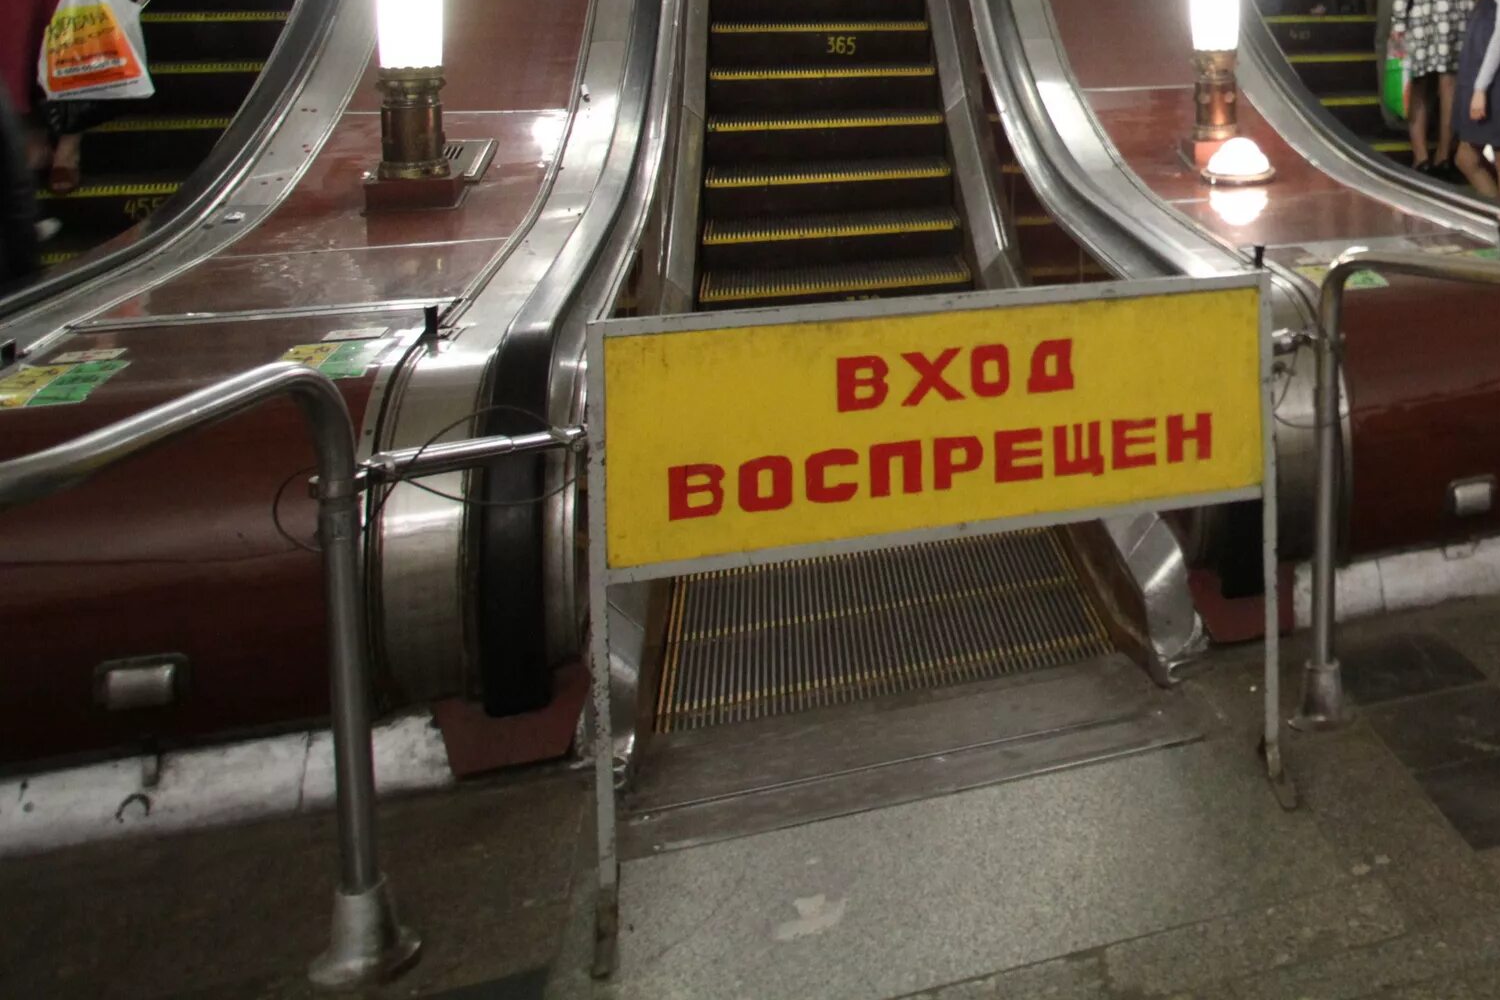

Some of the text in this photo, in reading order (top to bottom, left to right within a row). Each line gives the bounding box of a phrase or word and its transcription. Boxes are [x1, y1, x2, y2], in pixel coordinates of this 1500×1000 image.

[826, 35, 857, 56] 365
[836, 338, 1074, 412] ВХОД
[668, 412, 1212, 520] ВОСПРЕЩЕН
